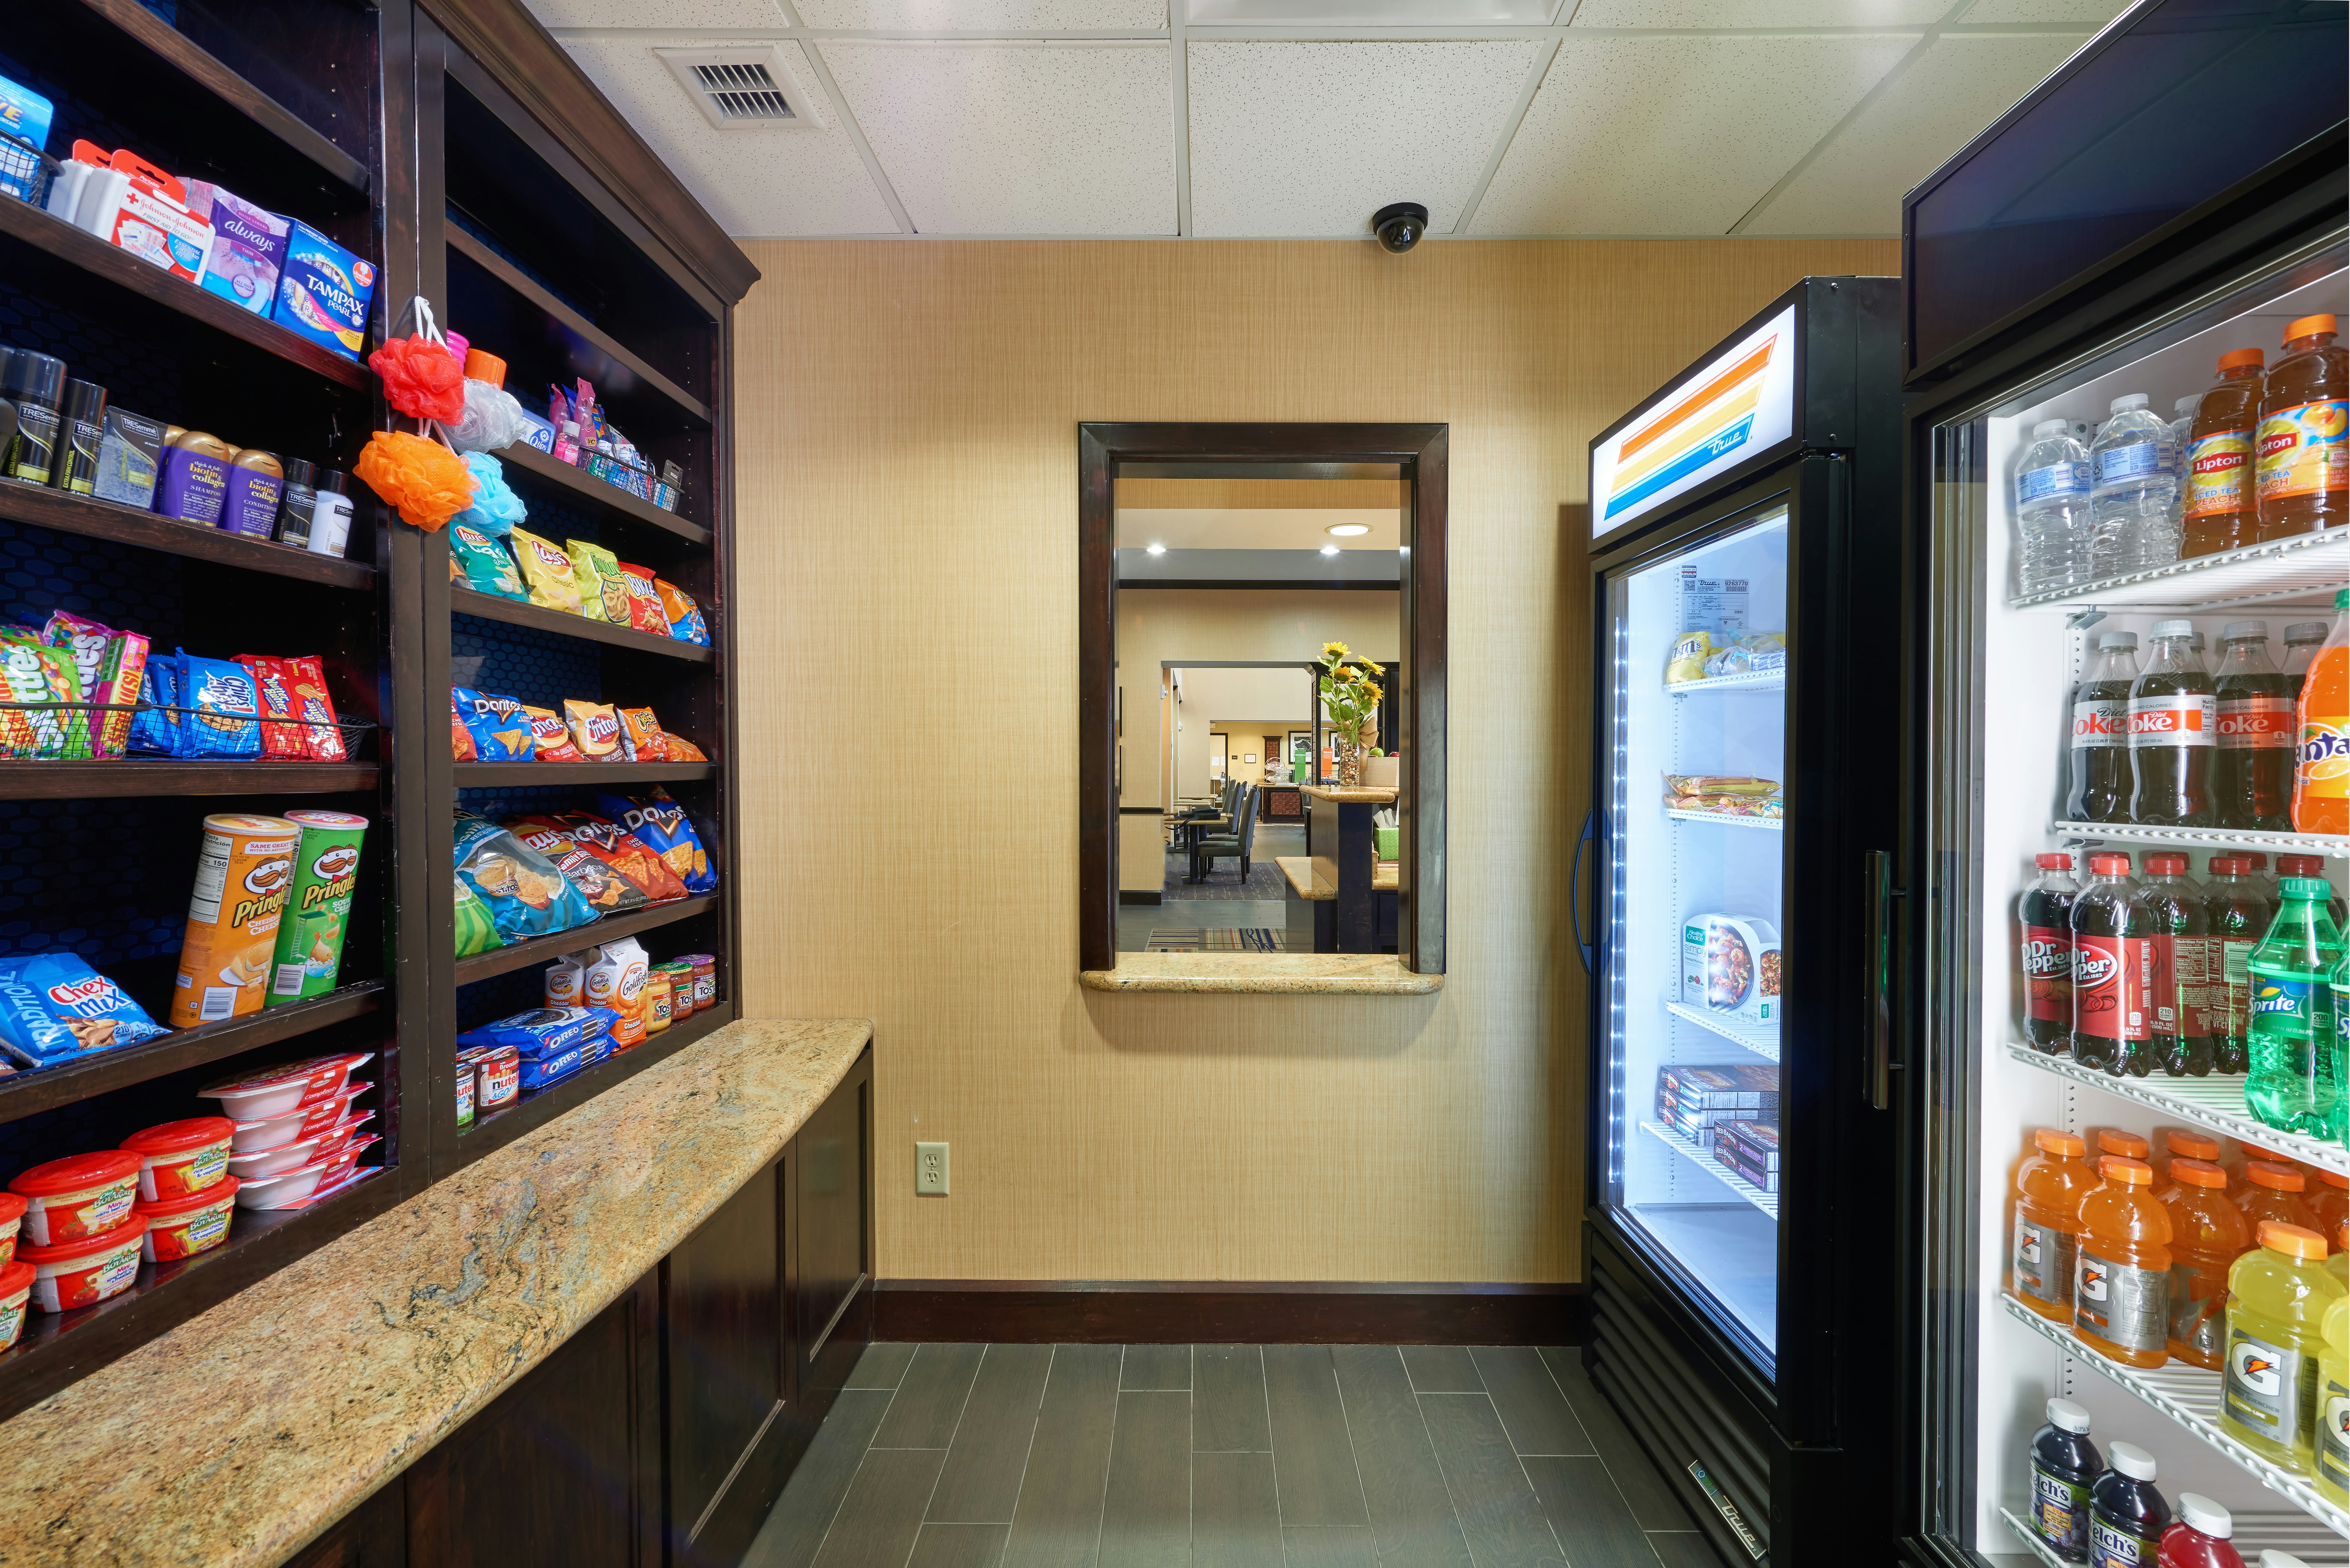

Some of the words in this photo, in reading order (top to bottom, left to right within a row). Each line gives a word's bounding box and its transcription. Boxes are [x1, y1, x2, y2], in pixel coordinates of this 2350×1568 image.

[140, 176, 160, 189] Portable
[143, 213, 160, 223] FIRST
[238, 212, 251, 221] DAILY
[252, 219, 267, 229] LINERS
[225, 221, 275, 251] always
[174, 239, 200, 255] ESSENTIAL
[174, 245, 189, 255] FIRST
[190, 252, 200, 260] AID
[242, 248, 254, 256] THIN
[175, 251, 191, 261] ITEMS
[307, 274, 364, 315] TAMPAX
[123, 418, 156, 434] TRESemmé
[530, 436, 547, 450] Q-tips
[1708, 432, 1742, 455] true
[189, 463, 218, 478] biotin
[2196, 455, 2242, 472] Lipton
[192, 474, 225, 488] collagen
[249, 481, 274, 494] biotin
[2288, 483, 2308, 492] FLAVORS
[190, 485, 221, 497] SHAMPOO
[251, 492, 278, 503] collagen
[2195, 490, 2217, 500] ICED
[2195, 494, 2237, 508] PEACH
[459, 529, 486, 541] Lay's
[532, 541, 566, 565] Lay's
[552, 576, 574, 588] Classic
[263, 679, 290, 702] Nutter
[263, 688, 287, 712] Butter
[475, 699, 525, 713] Doritos
[2098, 707, 2127, 717] Diet
[585, 716, 618, 742] Fritos
[332, 897, 350, 907] SOUR
[1685, 944, 1707, 957] simply
[2030, 941, 2056, 958] Dr
[70, 976, 91, 986] SAVORY
[552, 978, 572, 987] Goldfish
[592, 978, 609, 987] Goldfish
[623, 969, 648, 996] Goldfish
[50, 976, 113, 1004] Chex
[629, 987, 639, 995] BAKED
[75, 989, 129, 1017] mix
[2249, 997, 2295, 1016] Sprite
[115, 1025, 129, 1035] 210
[624, 1018, 641, 1029] Cheddar
[550, 1027, 579, 1049] OREO
[549, 1051, 578, 1075] OREO
[1668, 1074, 1678, 1087] BARON
[305, 1085, 337, 1100] Compleats
[492, 1085, 512, 1099] &GO!
[304, 1116, 337, 1131] Compleats
[1723, 1129, 1736, 1145] BARON
[194, 1151, 226, 1168] BOYARDEE
[1723, 1149, 1736, 1165] BARON
[203, 1165, 223, 1176] vegetables
[320, 1169, 349, 1185] Compleats
[94, 1188, 132, 1209] BOYARDEE
[100, 1190, 114, 1200] Chef
[108, 1200, 122, 1210] Mini
[190, 1211, 226, 1231] BOYARDEE
[209, 1221, 225, 1230] chicken
[200, 1227, 223, 1238] vegetables
[2015, 1223, 2041, 1263] G
[103, 1251, 137, 1274] BOYARDEE
[117, 1263, 130, 1274] Mini
[2078, 1258, 2108, 1301] G
[2084, 1302, 2108, 1316] QUENCHER
[2231, 1342, 2282, 1397] G
[2236, 1400, 2266, 1419] LEMON-LIME
[2246, 1394, 2280, 1414] QUENCHER
[1722, 1495, 1756, 1549] true
[2058, 1513, 2069, 1522] GRAPES
